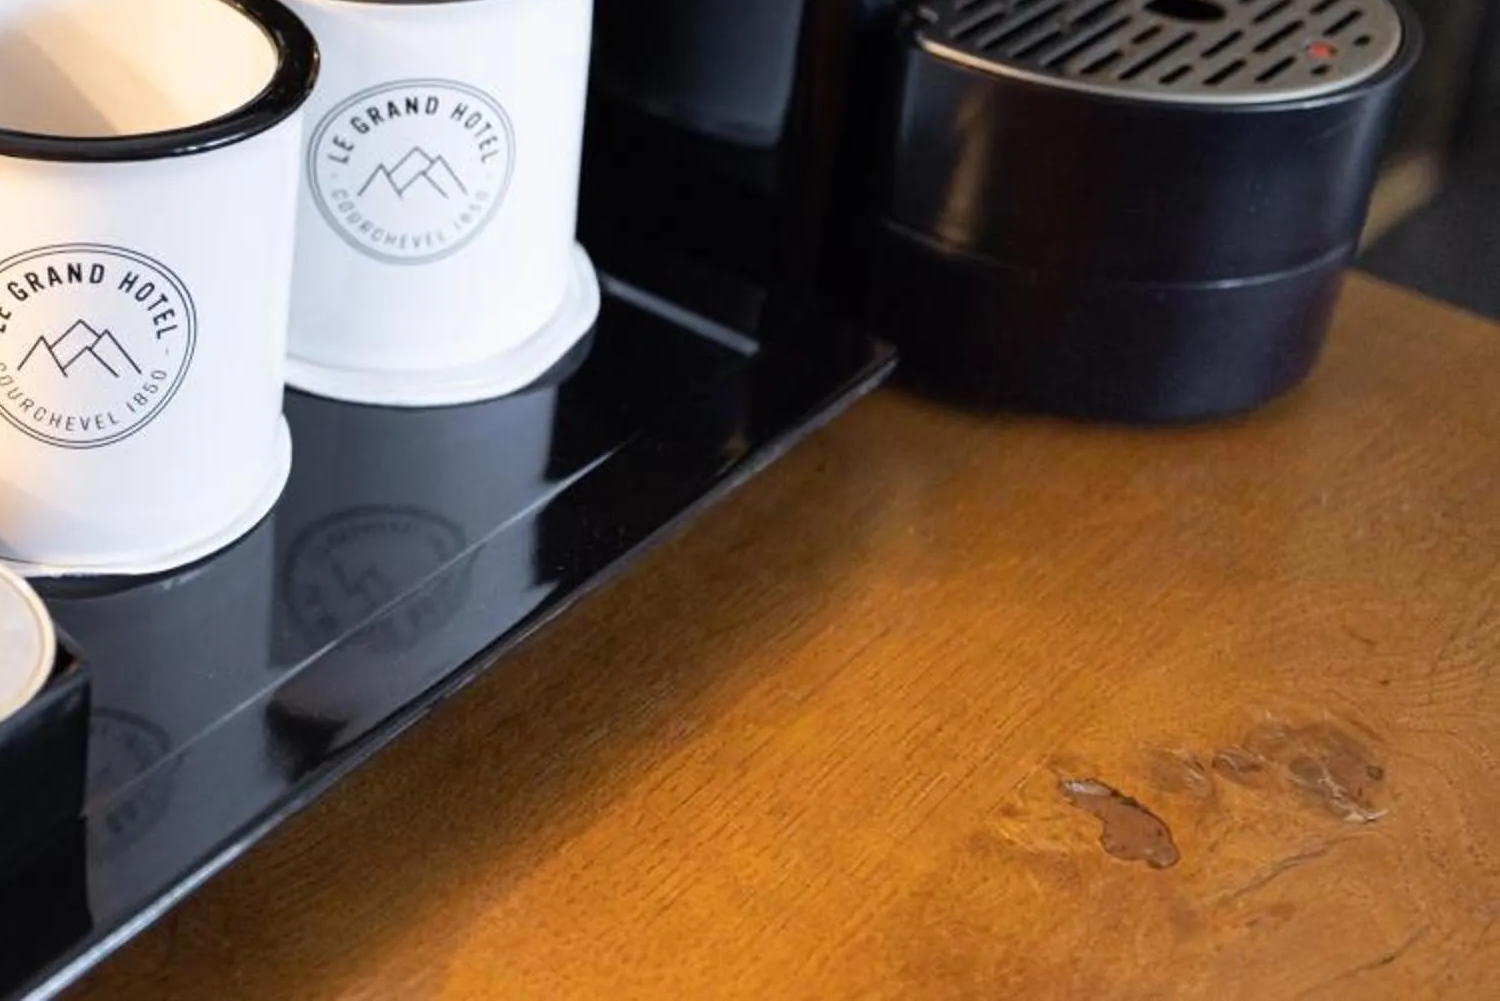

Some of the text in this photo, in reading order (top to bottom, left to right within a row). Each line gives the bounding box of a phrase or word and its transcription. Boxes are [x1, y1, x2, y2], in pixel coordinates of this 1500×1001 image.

[327, 96, 500, 165] LE GRAND HOTEL
[7, 262, 105, 302] GRAND
[117, 270, 178, 339] HOTEL
[126, 369, 167, 414] 1850
